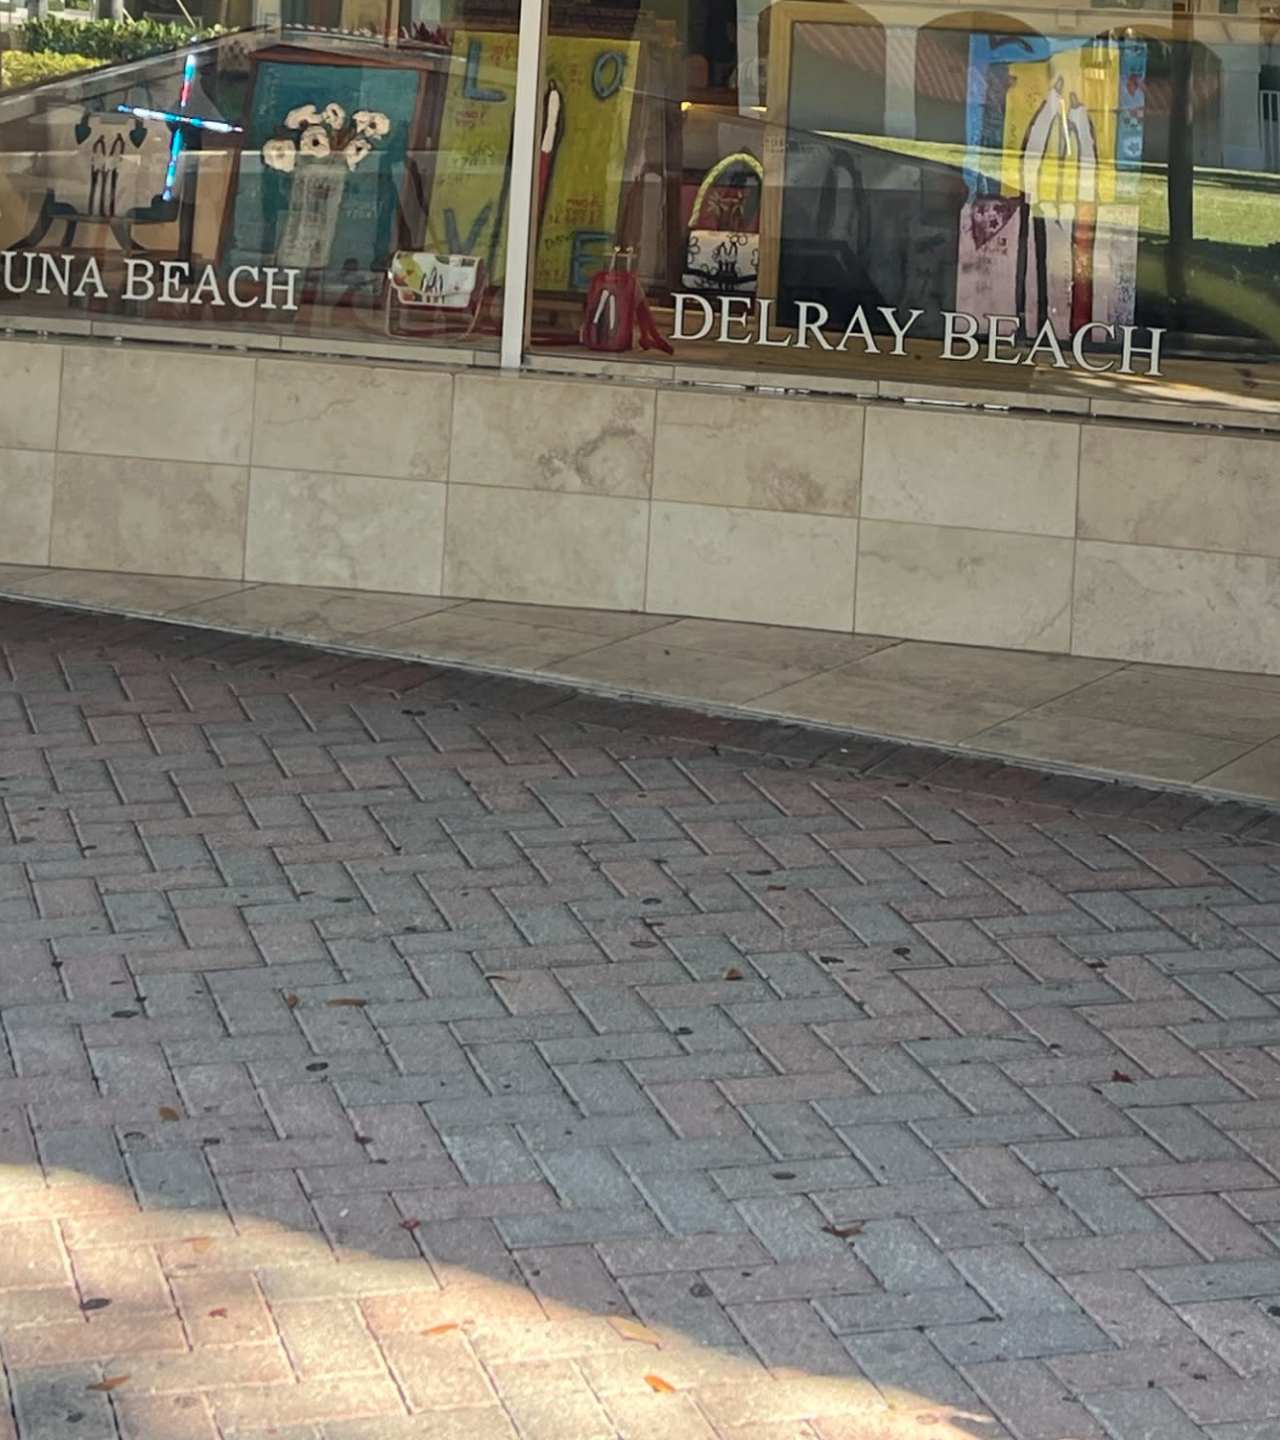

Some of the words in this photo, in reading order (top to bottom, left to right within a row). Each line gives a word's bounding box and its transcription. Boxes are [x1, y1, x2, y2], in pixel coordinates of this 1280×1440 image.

[122, 258, 300, 311] BEACH
[673, 292, 926, 357] DELRAY
[939, 312, 1167, 377] BEACH
